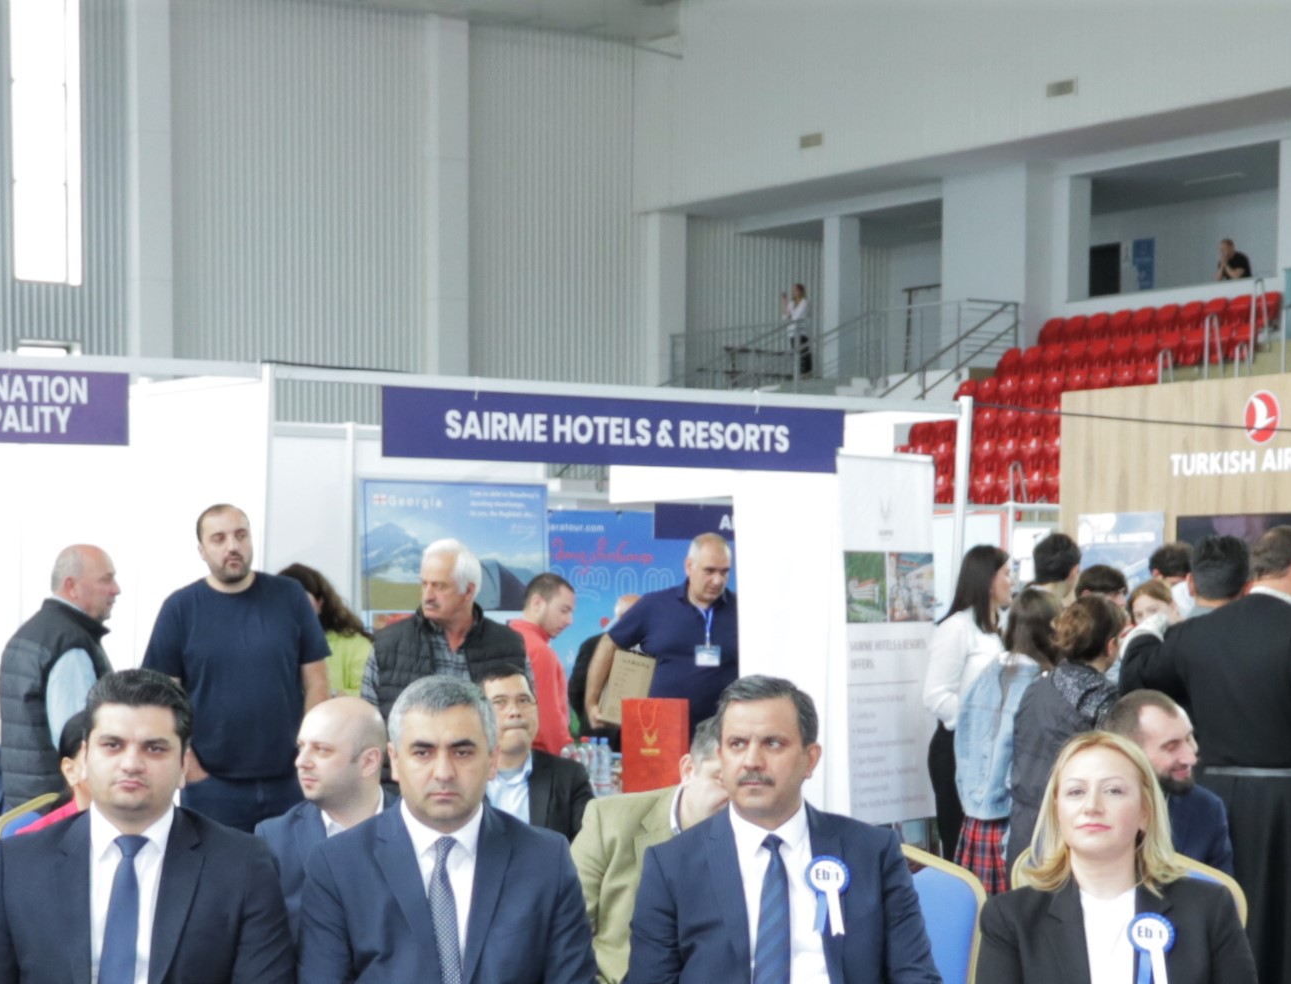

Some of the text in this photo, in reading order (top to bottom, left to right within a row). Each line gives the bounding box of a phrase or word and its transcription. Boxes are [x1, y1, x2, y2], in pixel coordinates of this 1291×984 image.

[444, 409, 790, 453] SAIRME HOTELS & RESORTS
[1170, 450, 1256, 476] TURKISH
[388, 494, 443, 510] Georgia
